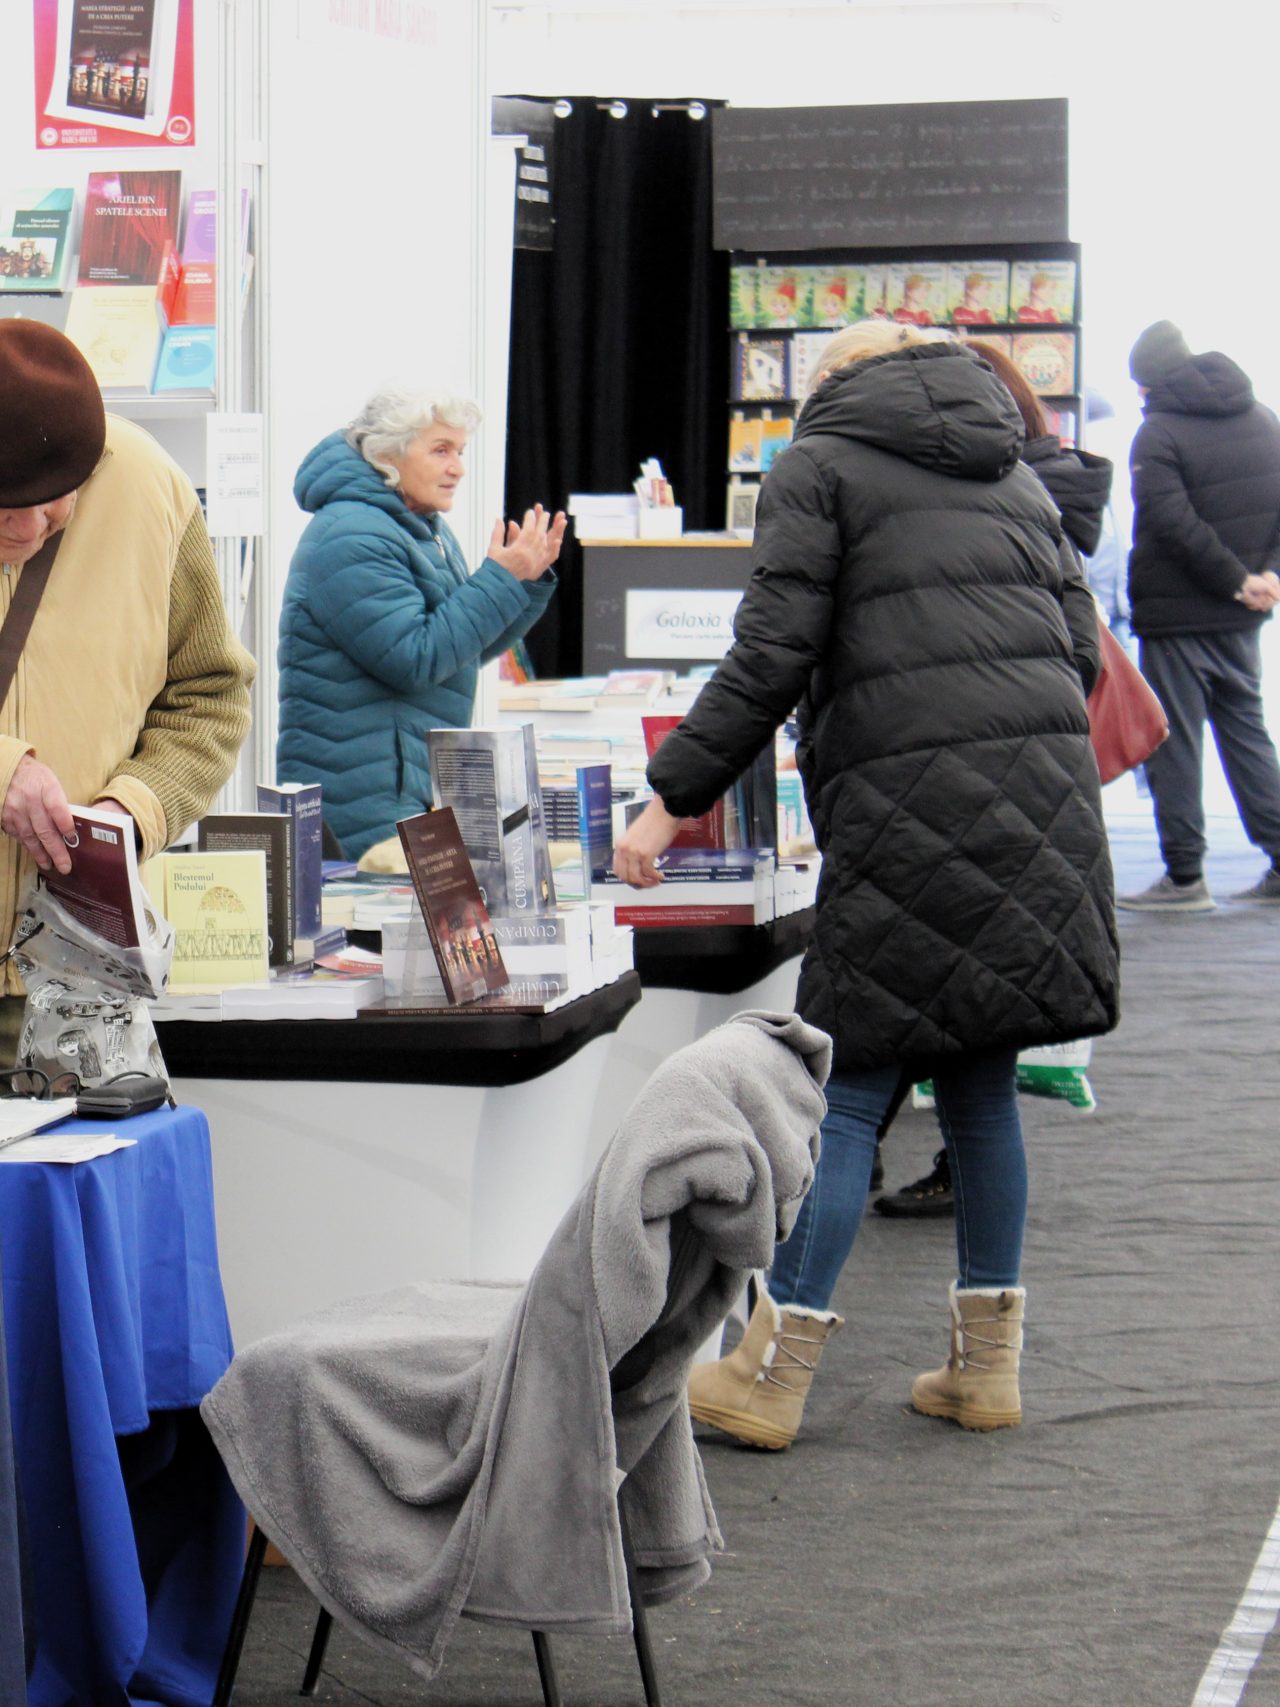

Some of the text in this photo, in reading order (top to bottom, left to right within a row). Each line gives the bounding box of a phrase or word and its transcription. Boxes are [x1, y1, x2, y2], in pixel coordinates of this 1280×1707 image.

[656, 610, 721, 629] Galaxia
[173, 872, 215, 882] Blestemul
[173, 881, 207, 892] Podului
